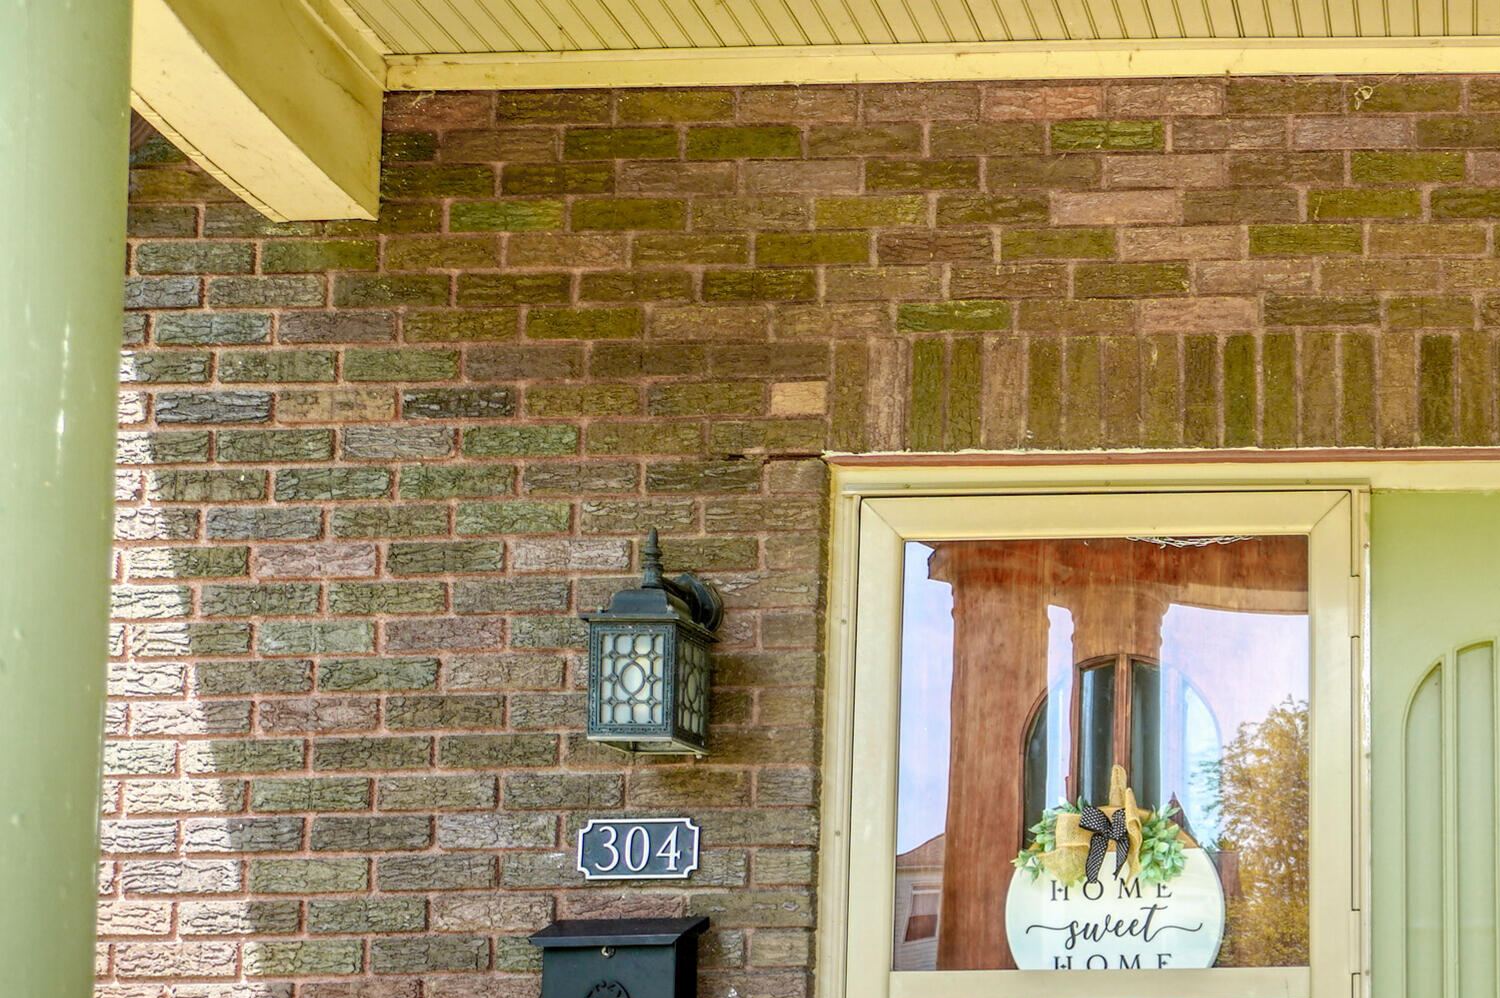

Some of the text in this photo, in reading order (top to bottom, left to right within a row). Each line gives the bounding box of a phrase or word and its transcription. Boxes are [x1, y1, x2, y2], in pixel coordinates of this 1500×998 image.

[594, 826, 682, 871] 304
[1050, 877, 1172, 901] HOME
[1025, 903, 1203, 950] sweet
